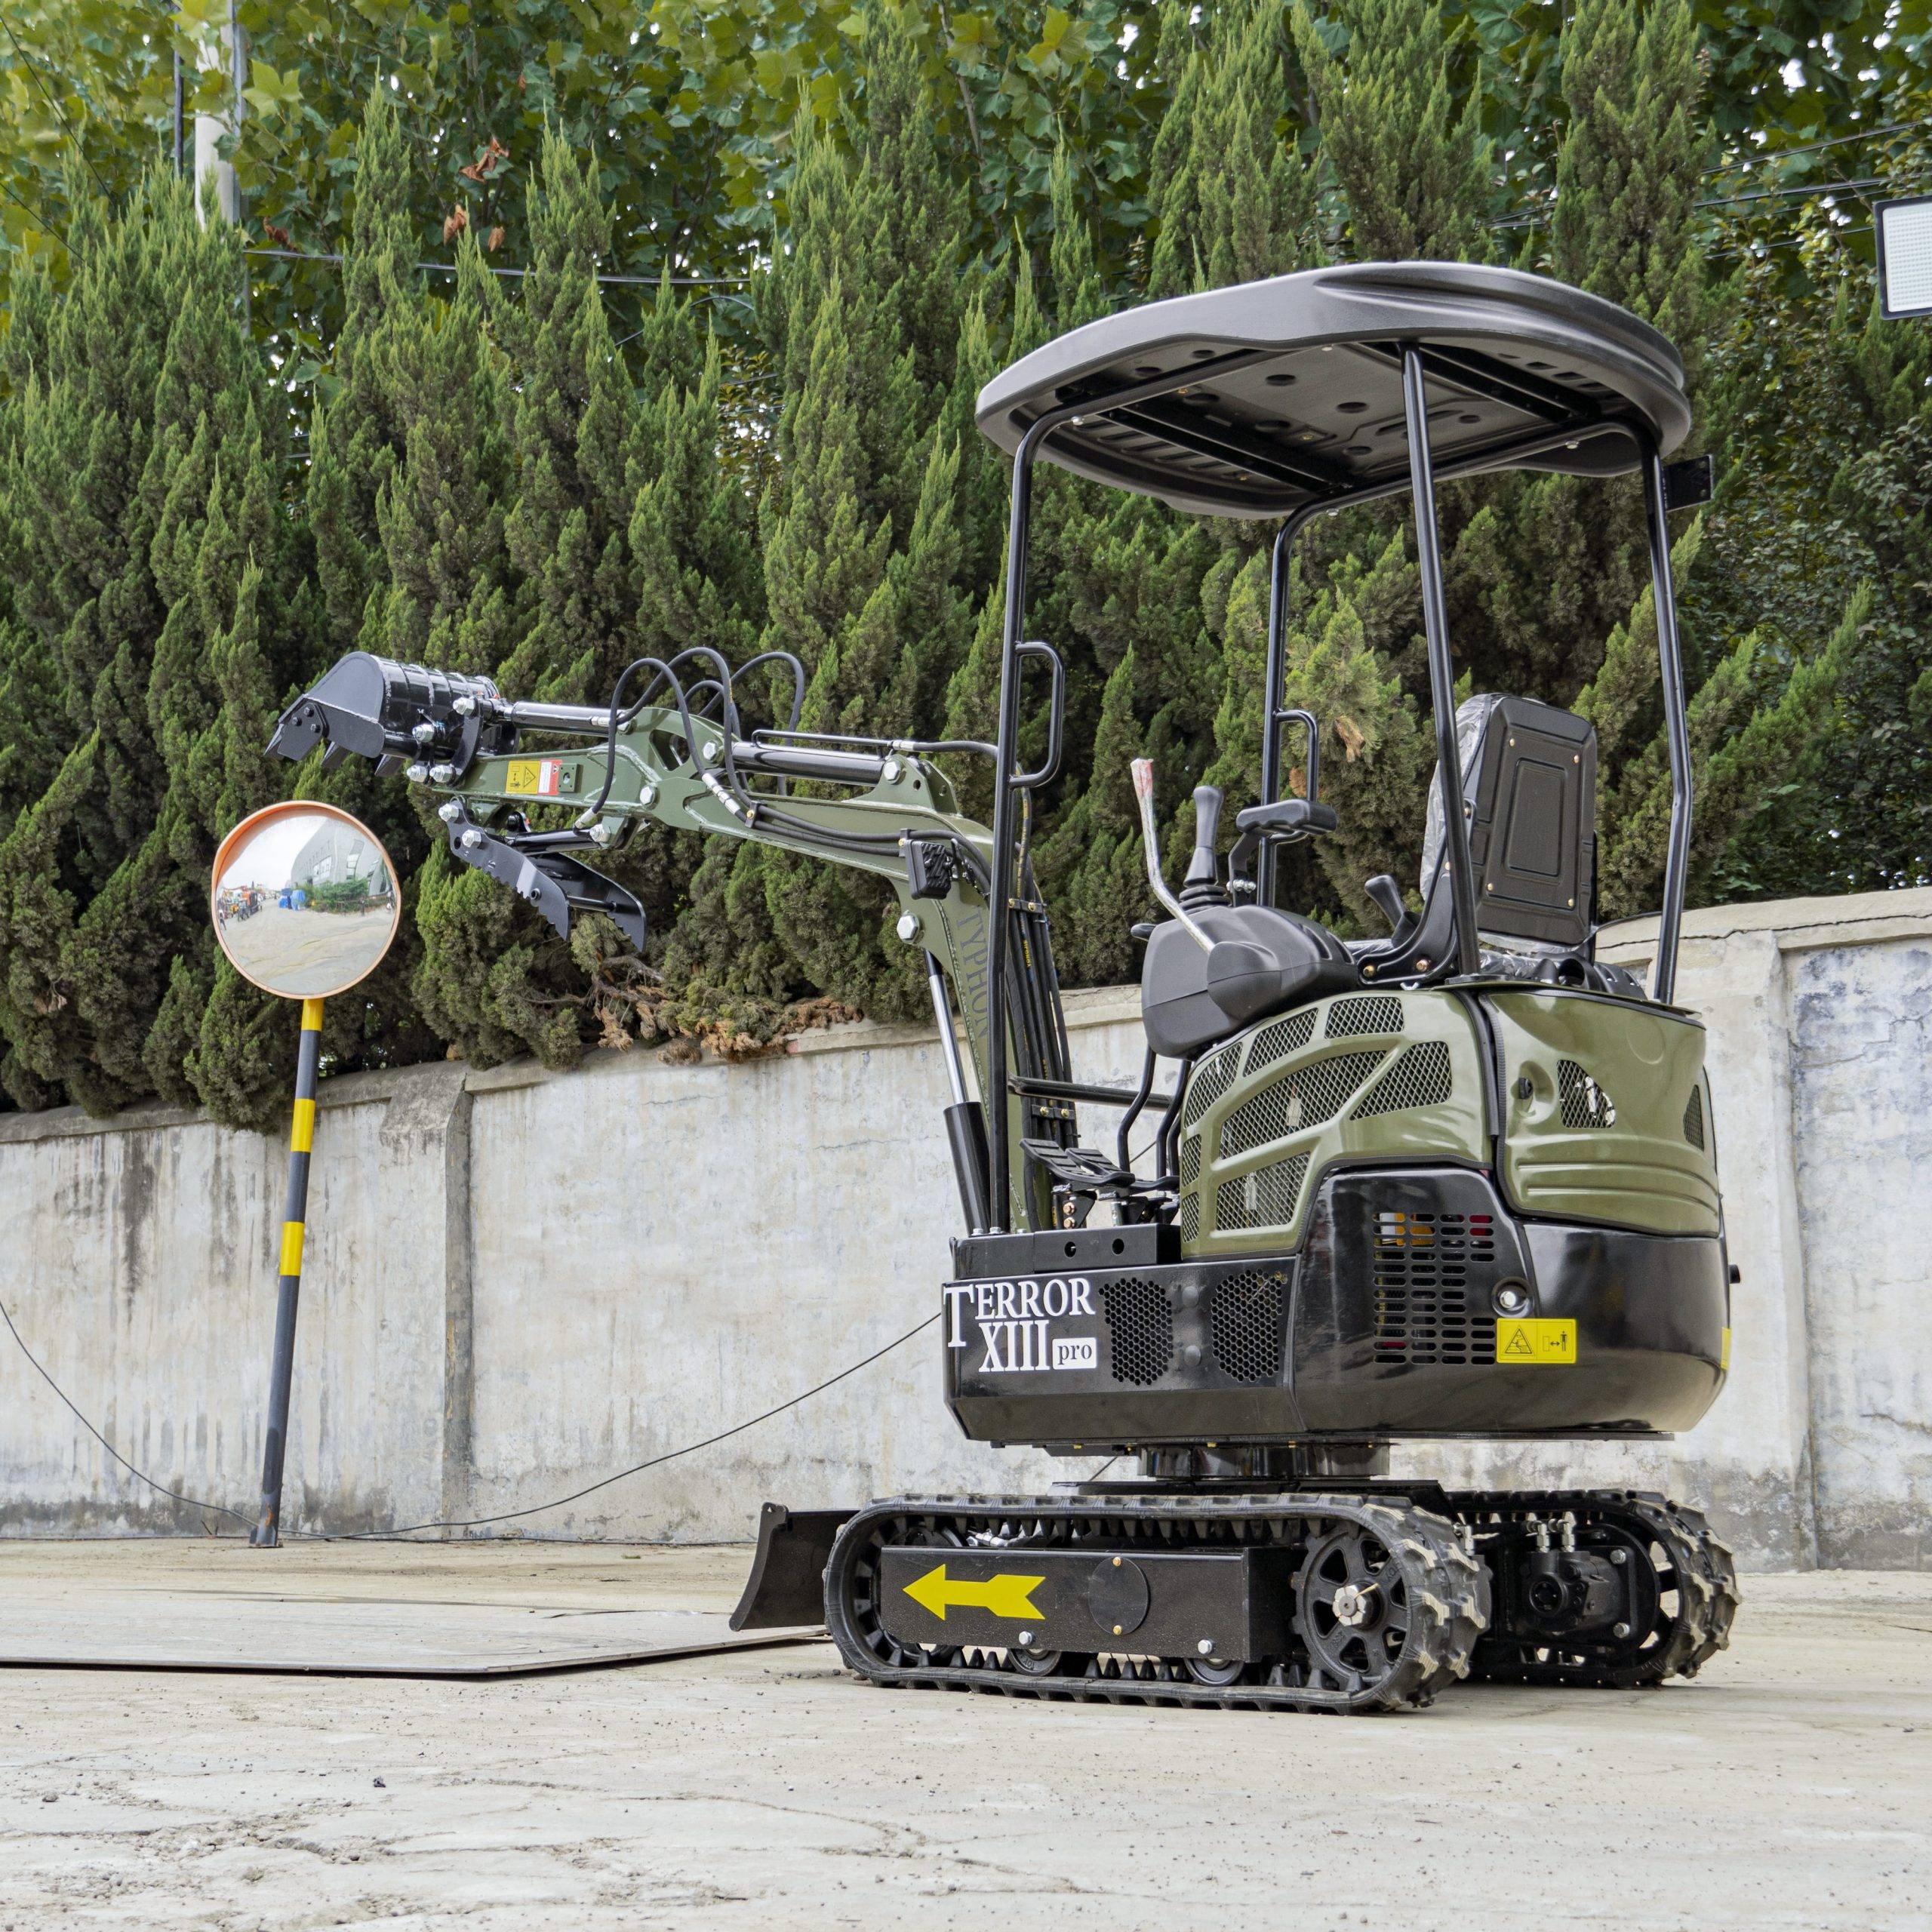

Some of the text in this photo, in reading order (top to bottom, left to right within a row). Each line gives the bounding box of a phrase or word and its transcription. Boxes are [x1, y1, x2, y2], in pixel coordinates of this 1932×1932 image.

[943, 1278, 1096, 1348] TERROR
[978, 1319, 1093, 1373] XIII pro
